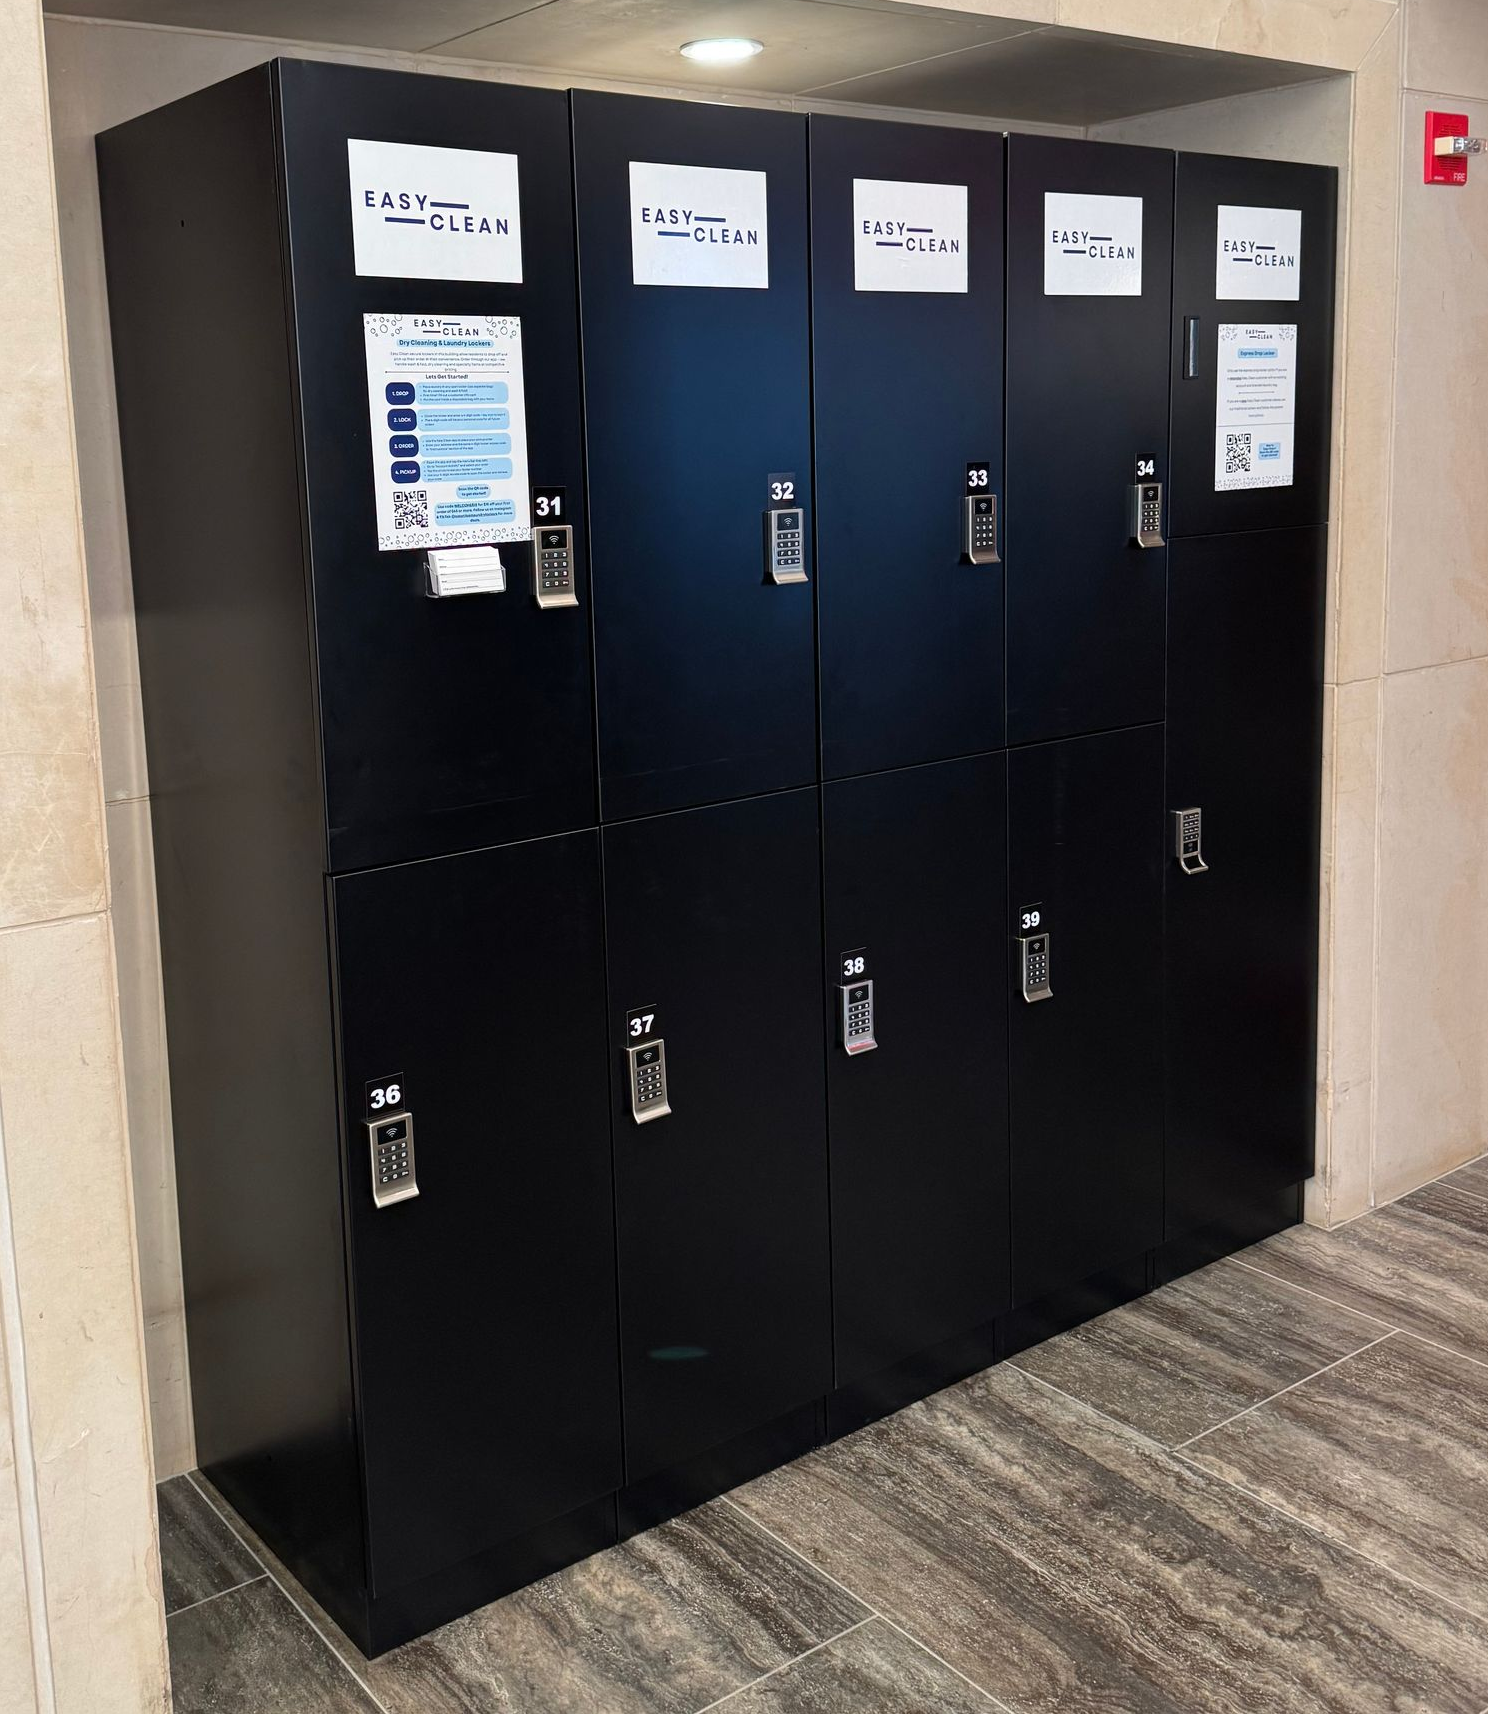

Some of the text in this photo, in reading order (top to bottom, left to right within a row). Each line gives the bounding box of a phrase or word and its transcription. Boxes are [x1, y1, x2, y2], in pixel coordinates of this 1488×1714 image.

[1454, 172, 1466, 182] FIRE
[365, 191, 428, 211] EASY
[430, 214, 508, 234] CLEAN
[642, 208, 692, 225] EASY
[694, 228, 758, 244] CLEAN
[864, 220, 906, 236] EASY
[906, 238, 959, 252] CLEAN
[1052, 230, 1088, 244] EASY
[1089, 246, 1134, 258] CLEAN
[1224, 240, 1256, 252] EASY
[1255, 254, 1294, 268] CLEAN
[414, 319, 442, 327] EASY
[442, 328, 479, 336] CLEAN
[1138, 460, 1154, 476] 34
[968, 470, 988, 486] 33
[772, 482, 794, 500] 32
[536, 496, 560, 516] 31
[1022, 912, 1040, 929] 39
[844, 956, 864, 976] 38
[630, 1014, 654, 1036] 37
[370, 1084, 401, 1108] 36
